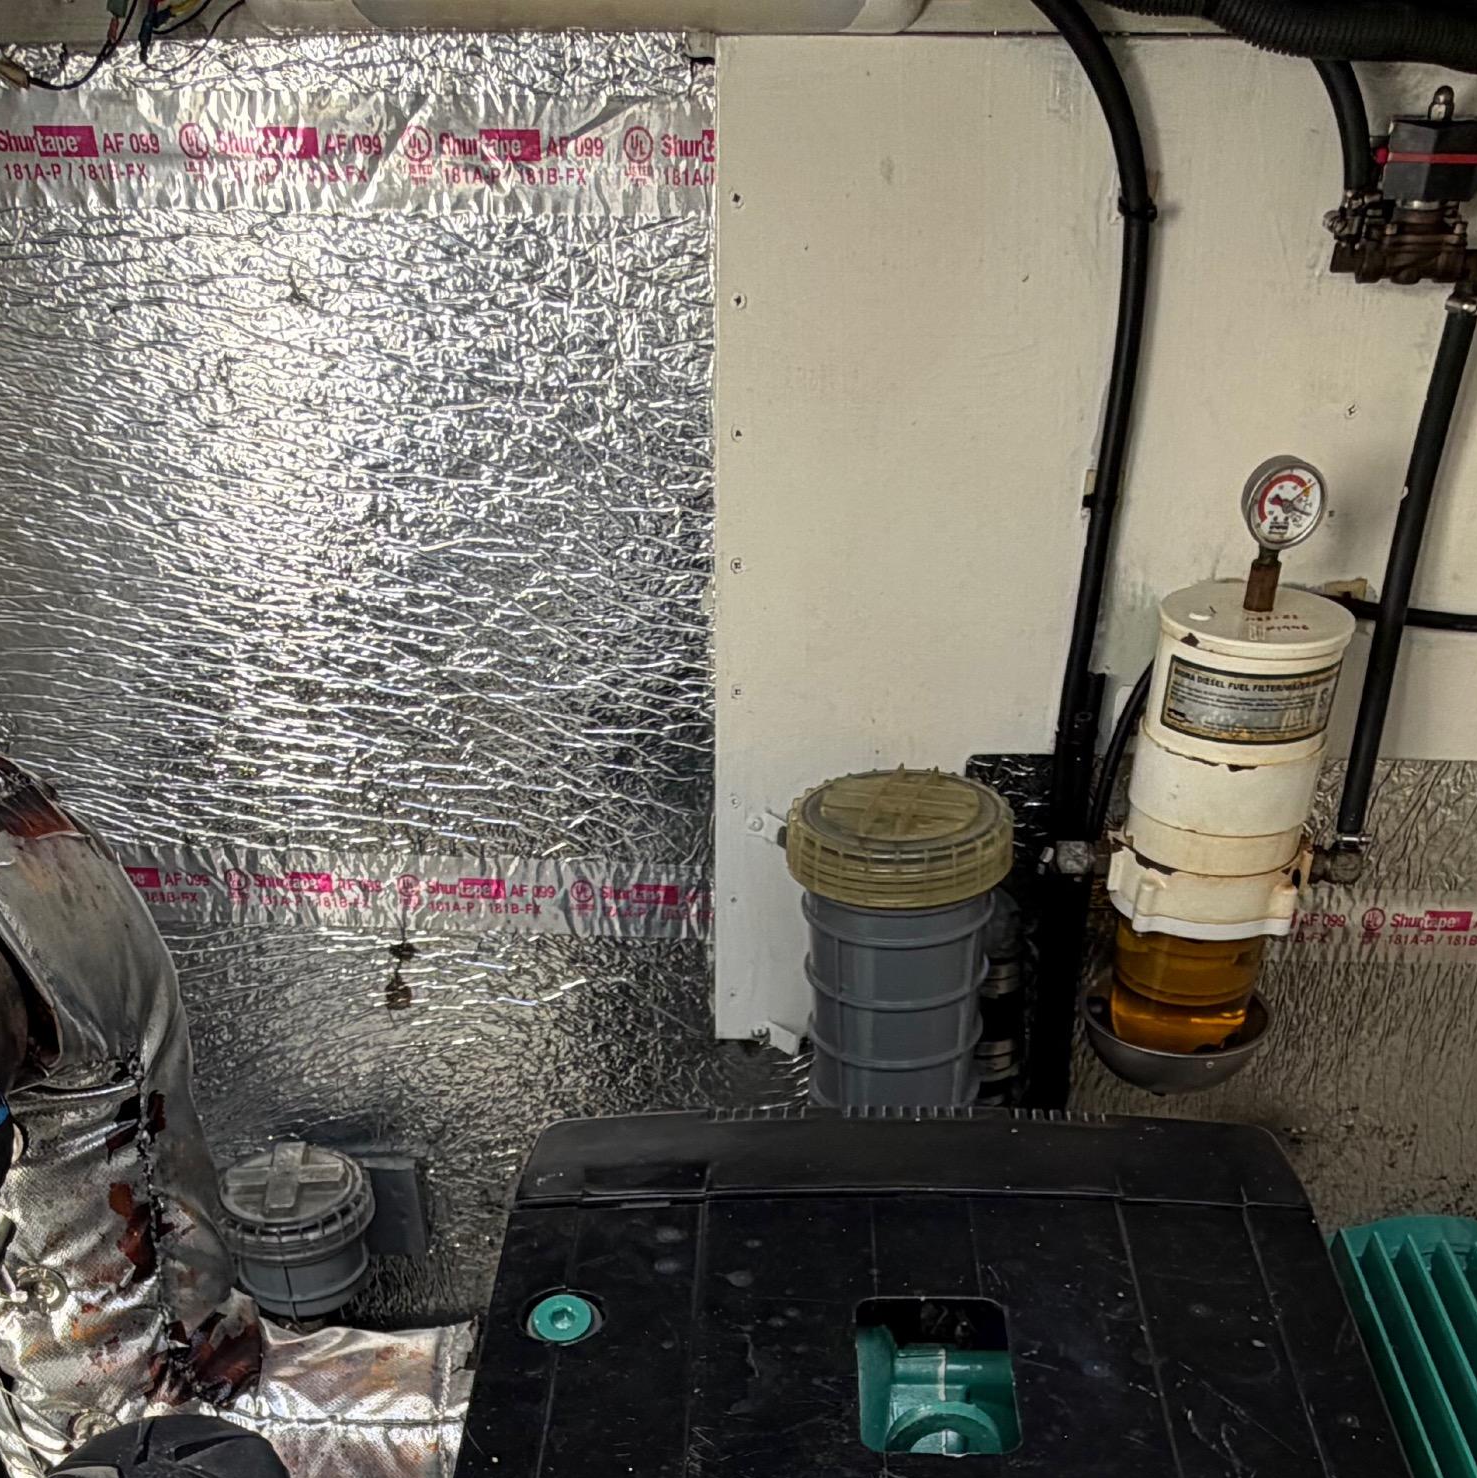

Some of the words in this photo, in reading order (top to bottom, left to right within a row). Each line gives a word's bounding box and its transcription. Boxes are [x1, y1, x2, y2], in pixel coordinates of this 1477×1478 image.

[103, 133, 124, 154] AF
[130, 133, 160, 154] 099
[4, 163, 61, 181] 181A-P
[165, 873, 183, 887] AF
[510, 885, 528, 897] AF
